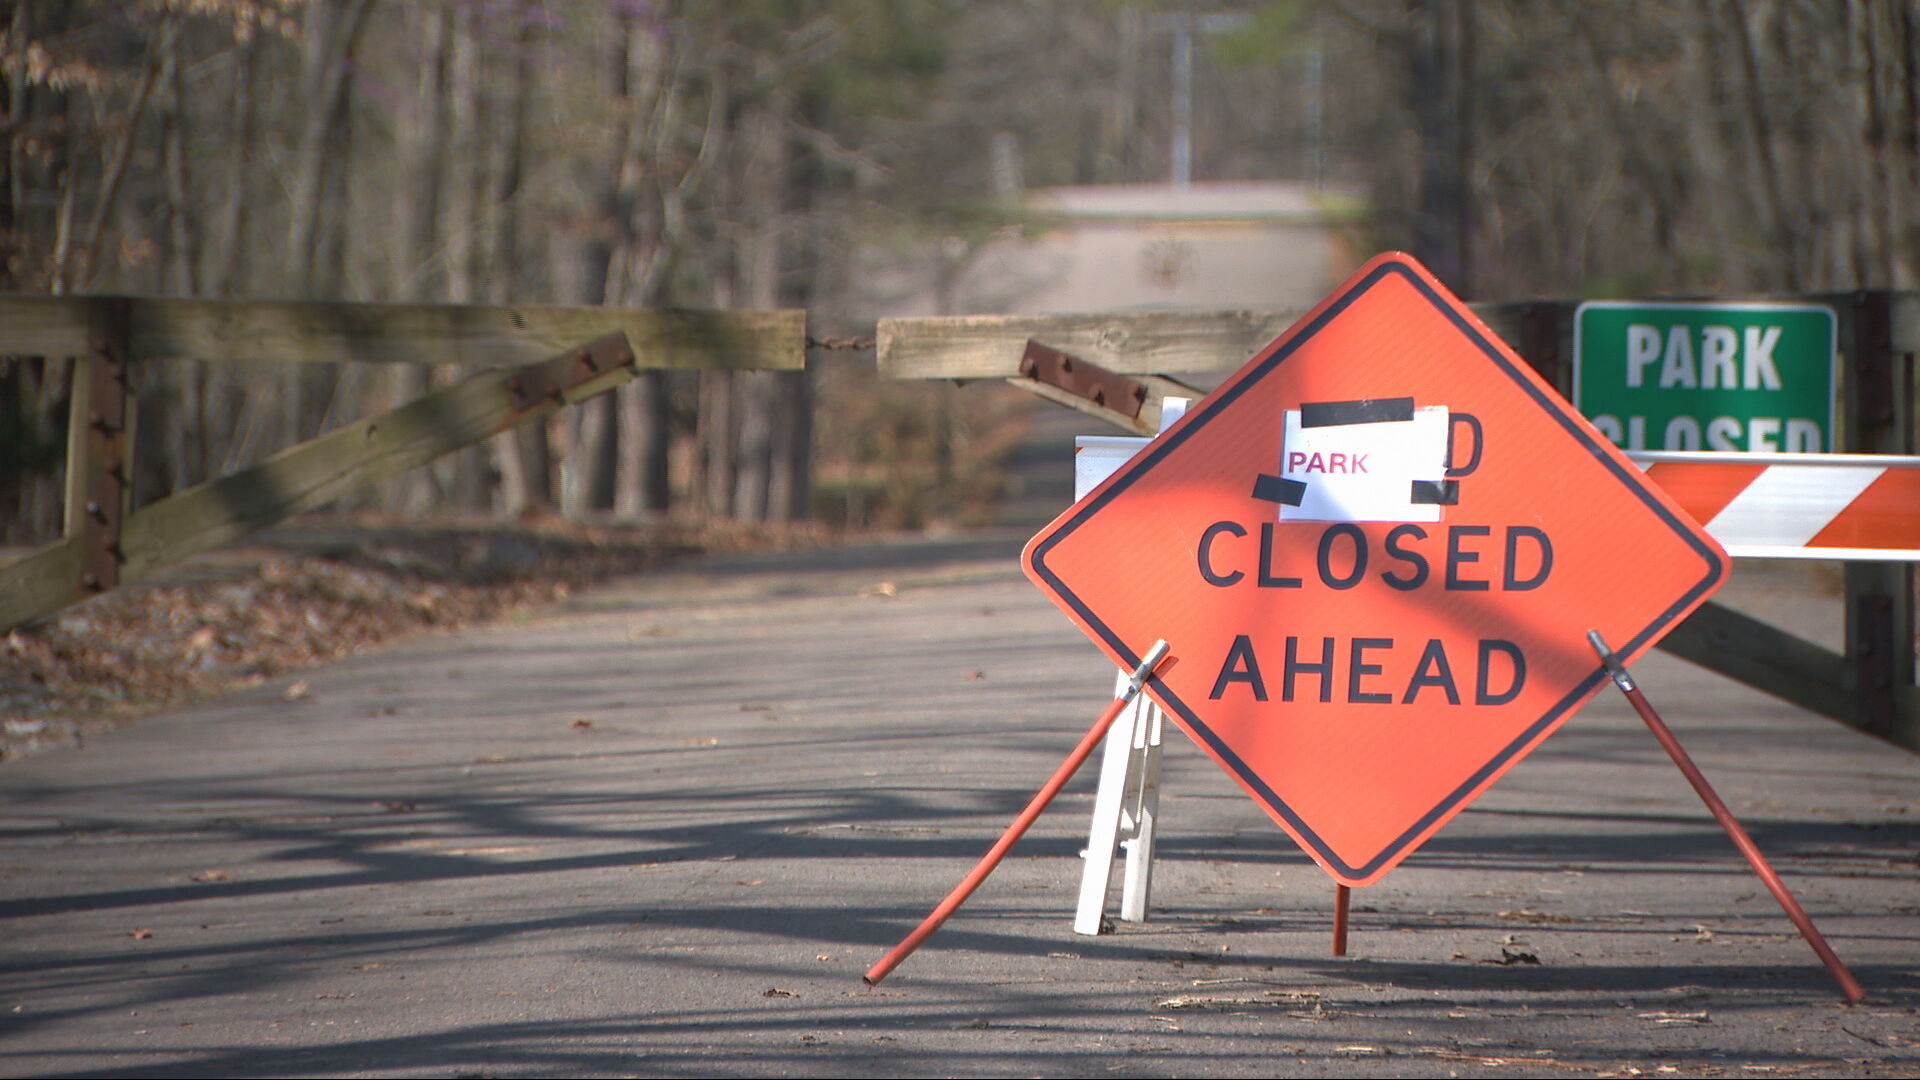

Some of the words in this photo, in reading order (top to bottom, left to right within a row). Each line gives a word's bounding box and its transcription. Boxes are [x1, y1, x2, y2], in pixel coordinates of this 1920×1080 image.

[1626, 324, 1783, 391] PARK
[1288, 451, 1369, 474] PARK
[1197, 521, 1553, 591] CLOSED
[1209, 634, 1527, 706] AHEAD
